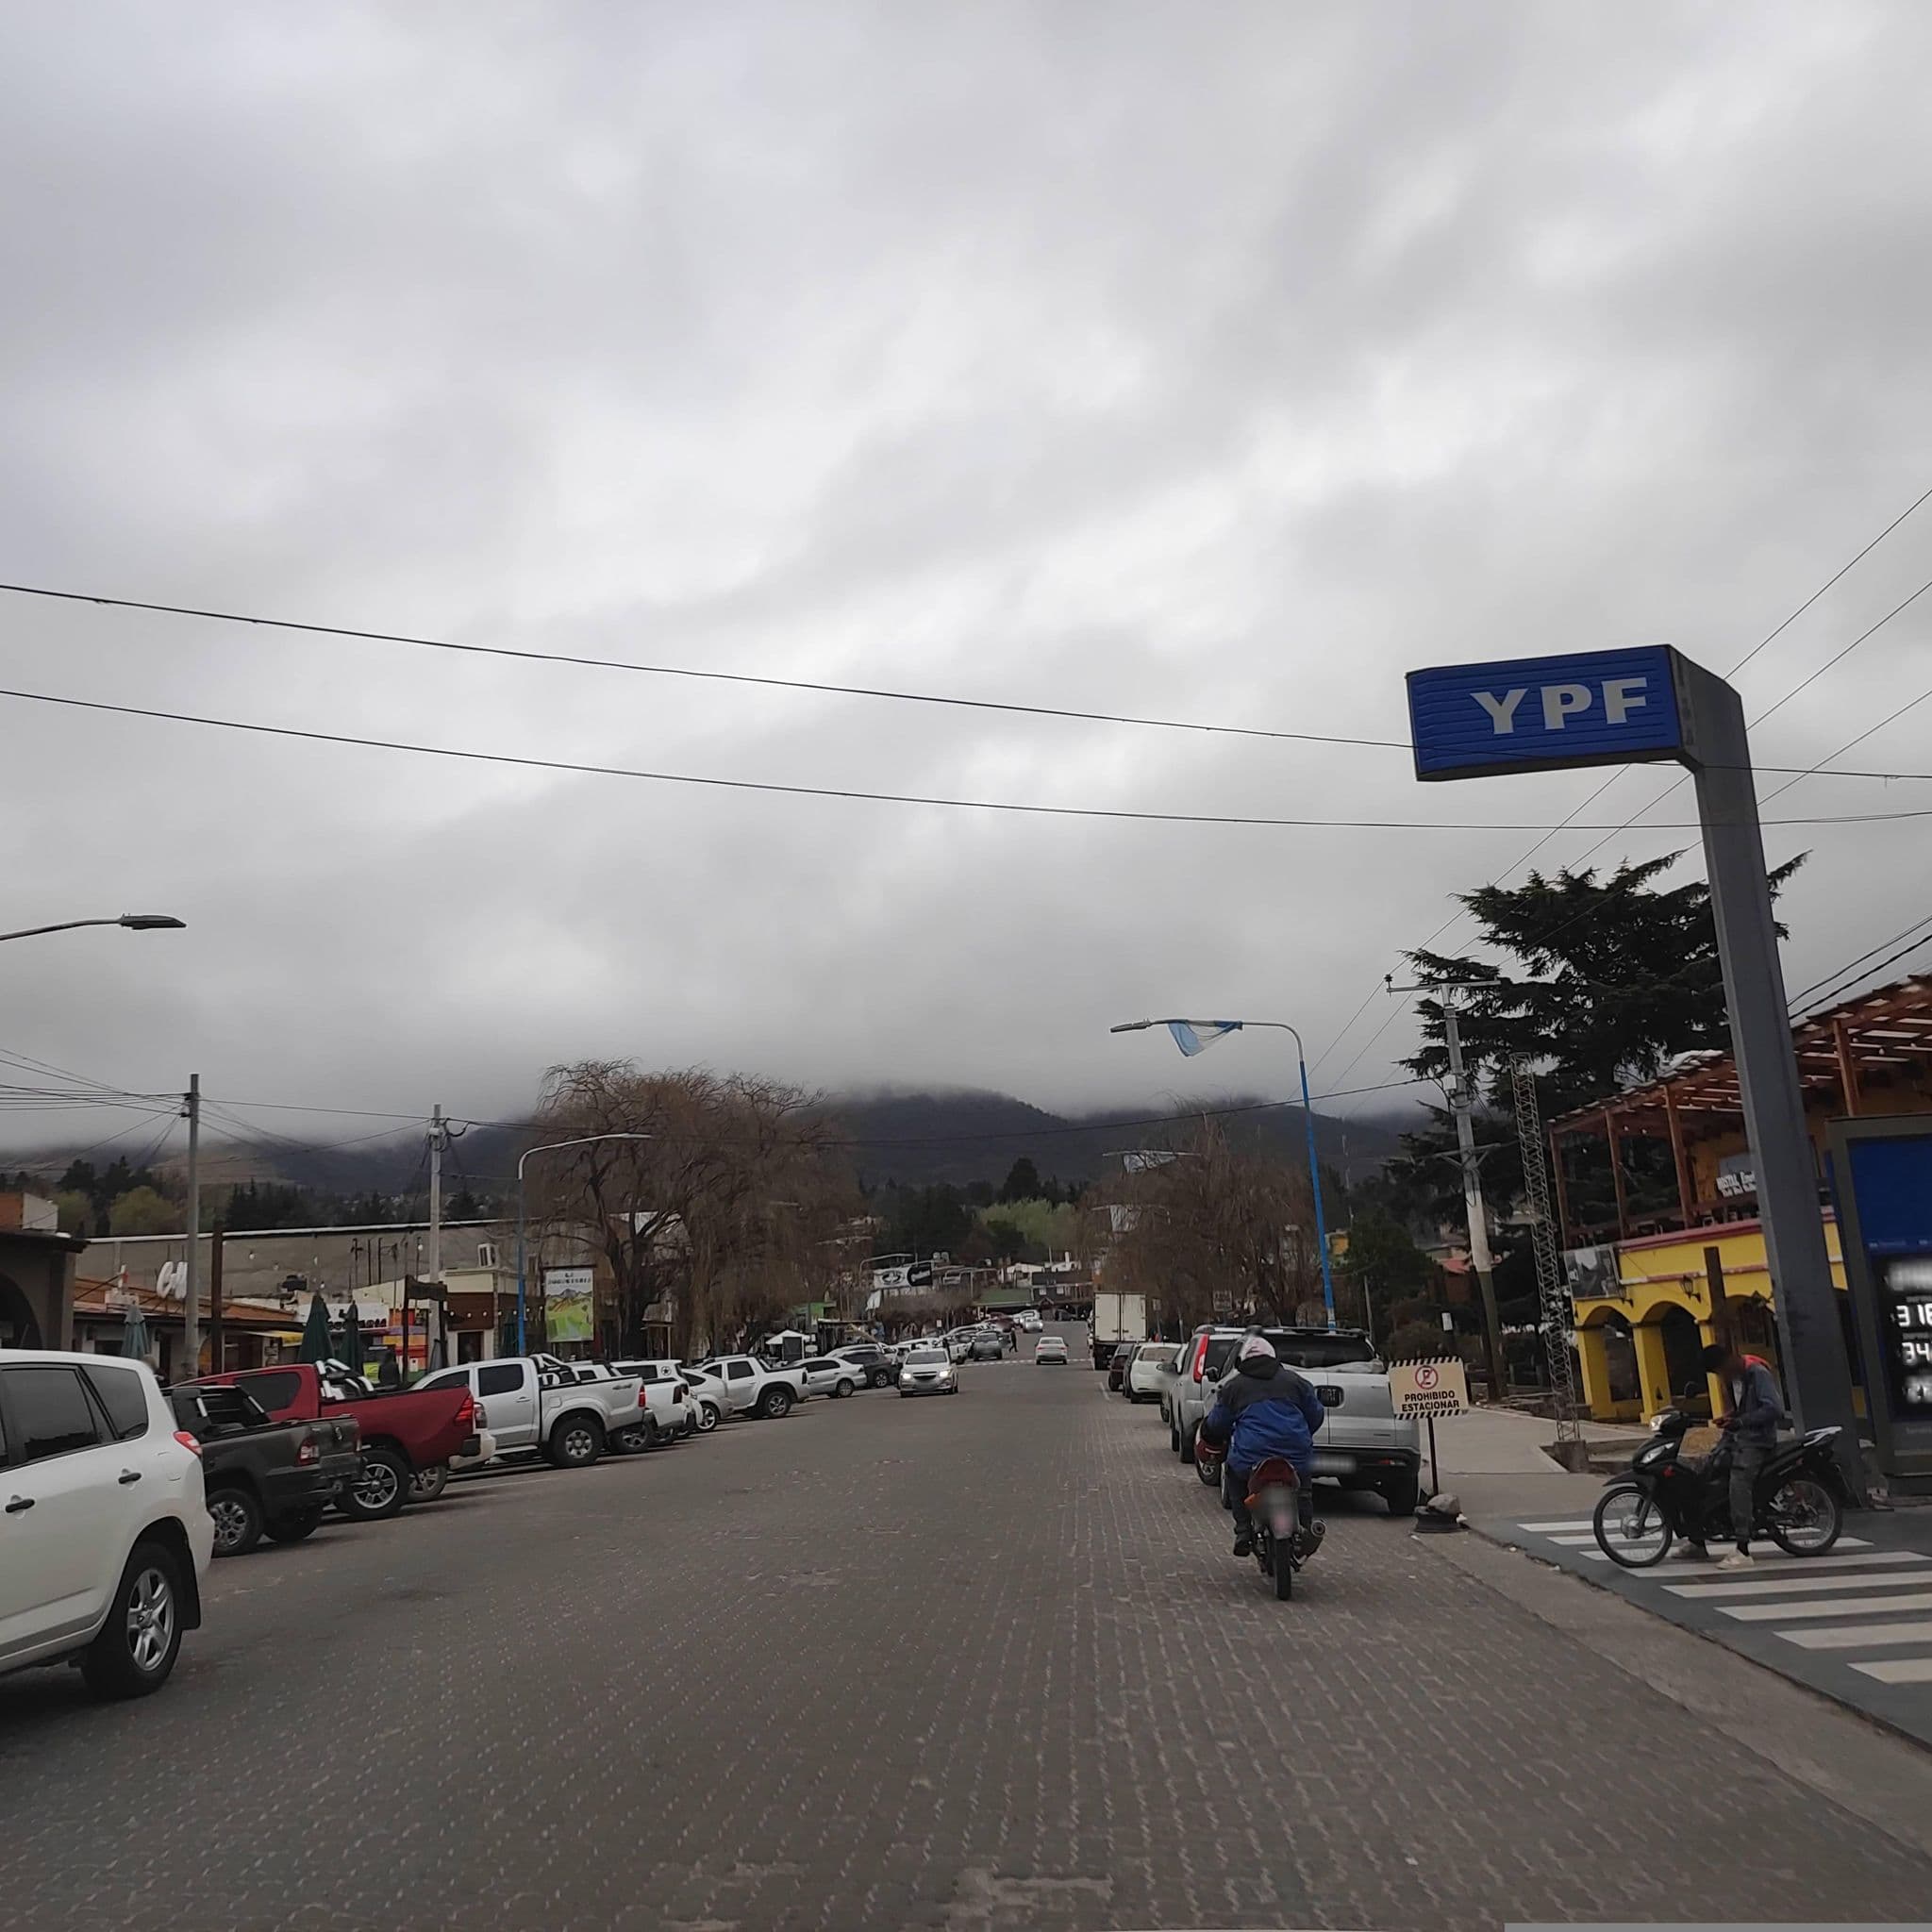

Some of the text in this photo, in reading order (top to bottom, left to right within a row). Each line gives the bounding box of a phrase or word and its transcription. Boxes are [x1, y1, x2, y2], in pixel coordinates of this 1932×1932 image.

[1469, 676, 1648, 735] YPF
[1902, 1341, 1932, 1365] 34
[1404, 1390, 1456, 1403] PROHIBIDO
[1402, 1400, 1460, 1412] ESTACIONAR
